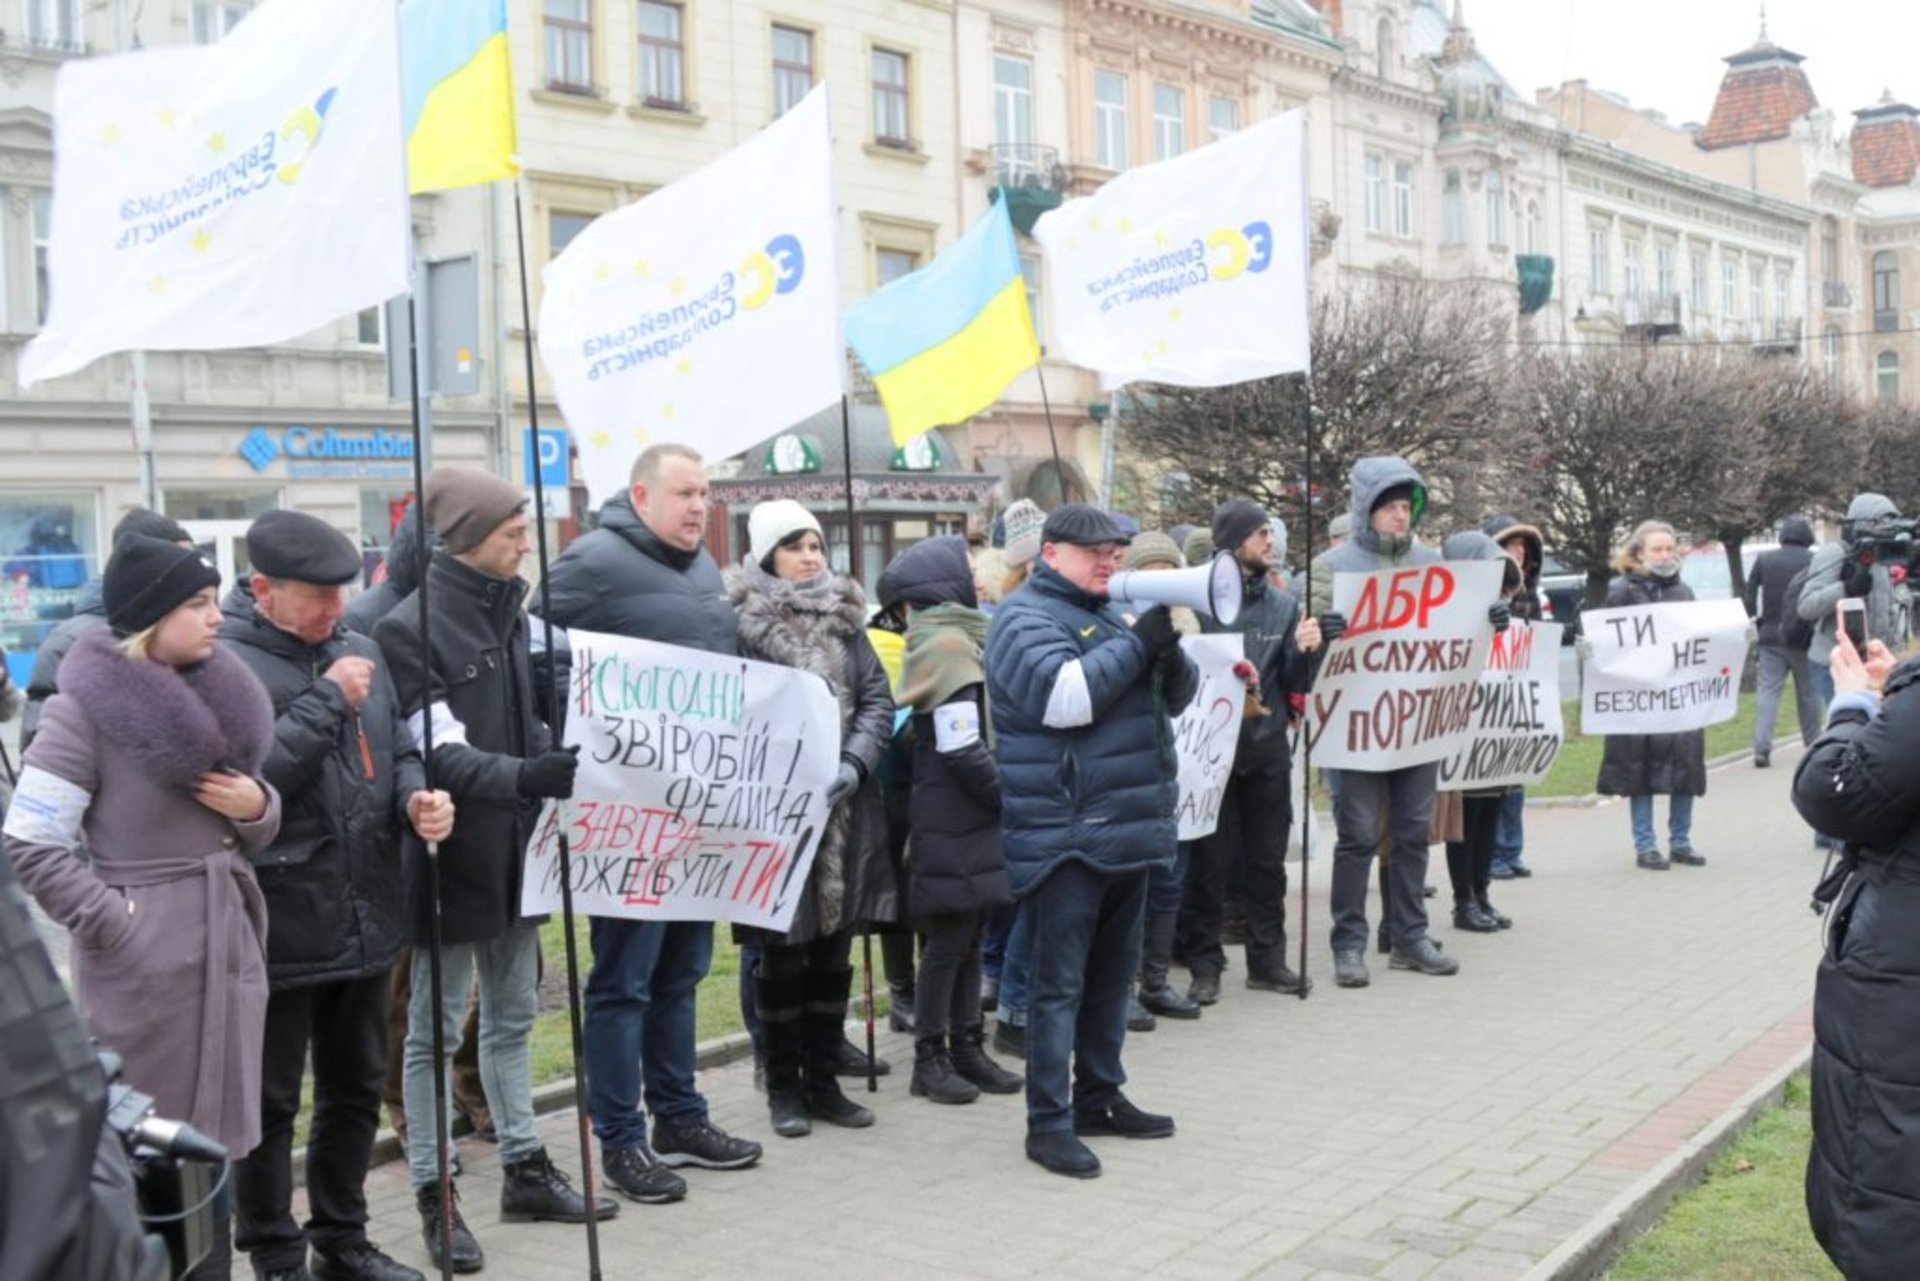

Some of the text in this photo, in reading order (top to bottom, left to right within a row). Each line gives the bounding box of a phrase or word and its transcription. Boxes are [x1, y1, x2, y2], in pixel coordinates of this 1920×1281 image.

[283, 425, 415, 458] Columbia
[1341, 565, 1455, 640] ДБР
[1605, 614, 1657, 648] ТИ
[1324, 647, 1357, 678] НА
[1672, 637, 1710, 669] НЕ
[1594, 666, 1731, 713] БЕЗСМЕРТНИЙ
[1463, 734, 1559, 781] КОЖНОГО
[666, 776, 812, 836] ФЕДИНА
